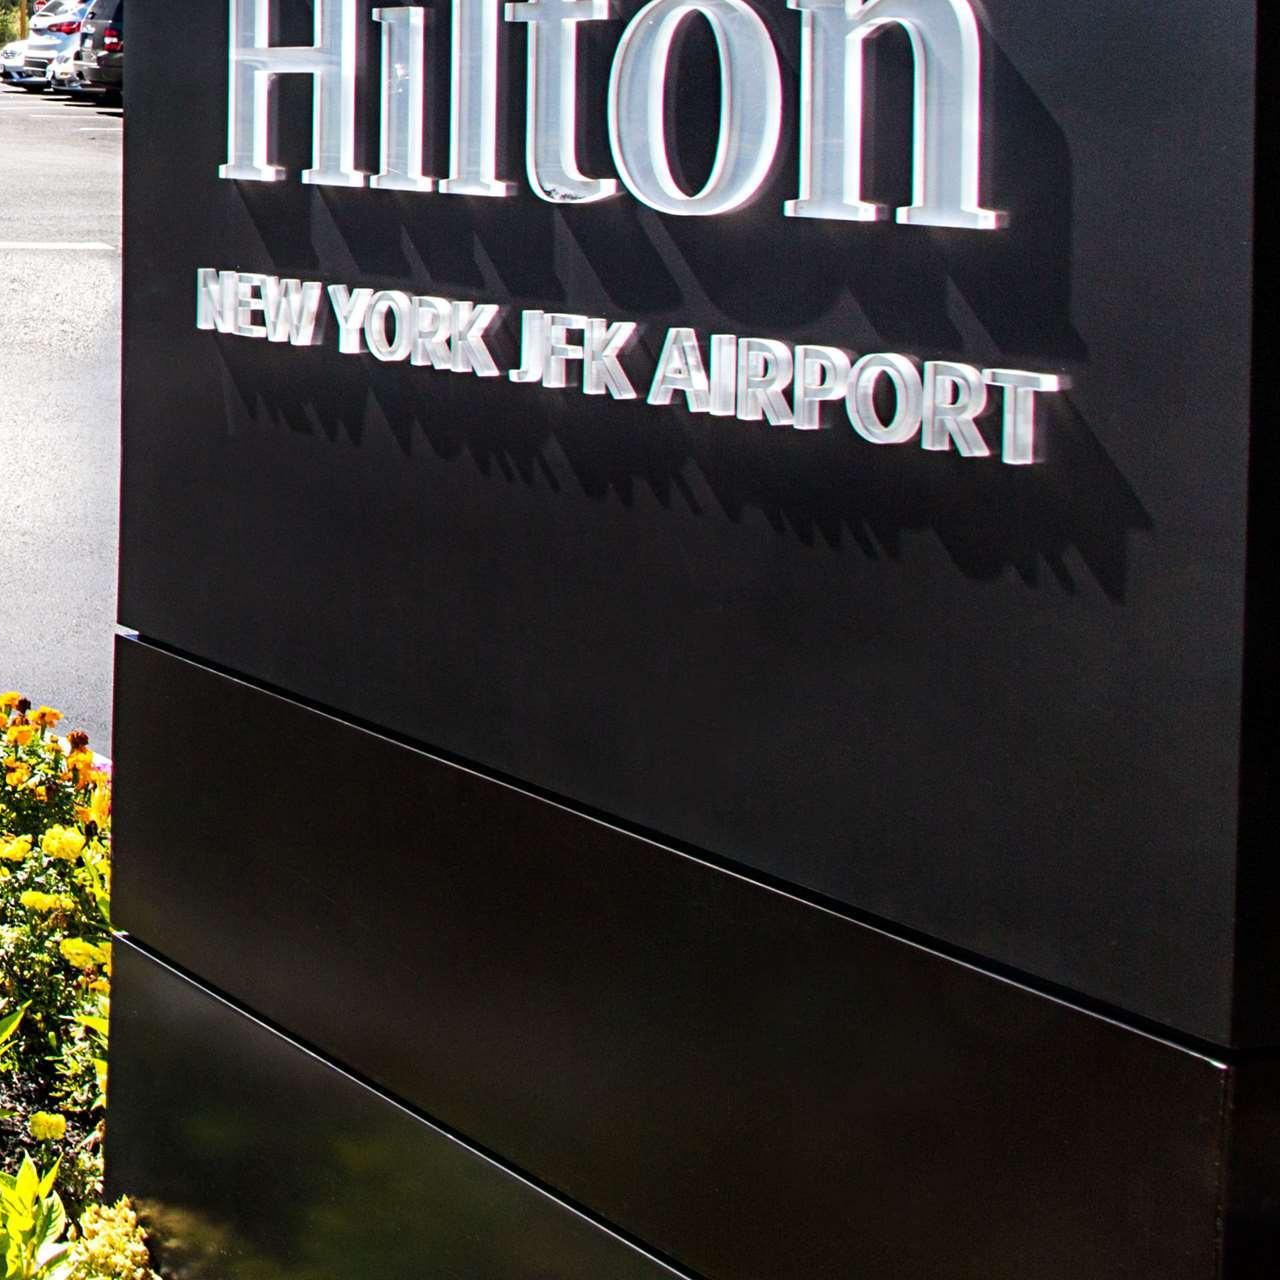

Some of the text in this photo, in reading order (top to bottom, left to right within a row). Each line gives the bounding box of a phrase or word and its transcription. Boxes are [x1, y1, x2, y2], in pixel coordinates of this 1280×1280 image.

[197, 268, 1060, 464] NEW YORK JFK AIRPORT
